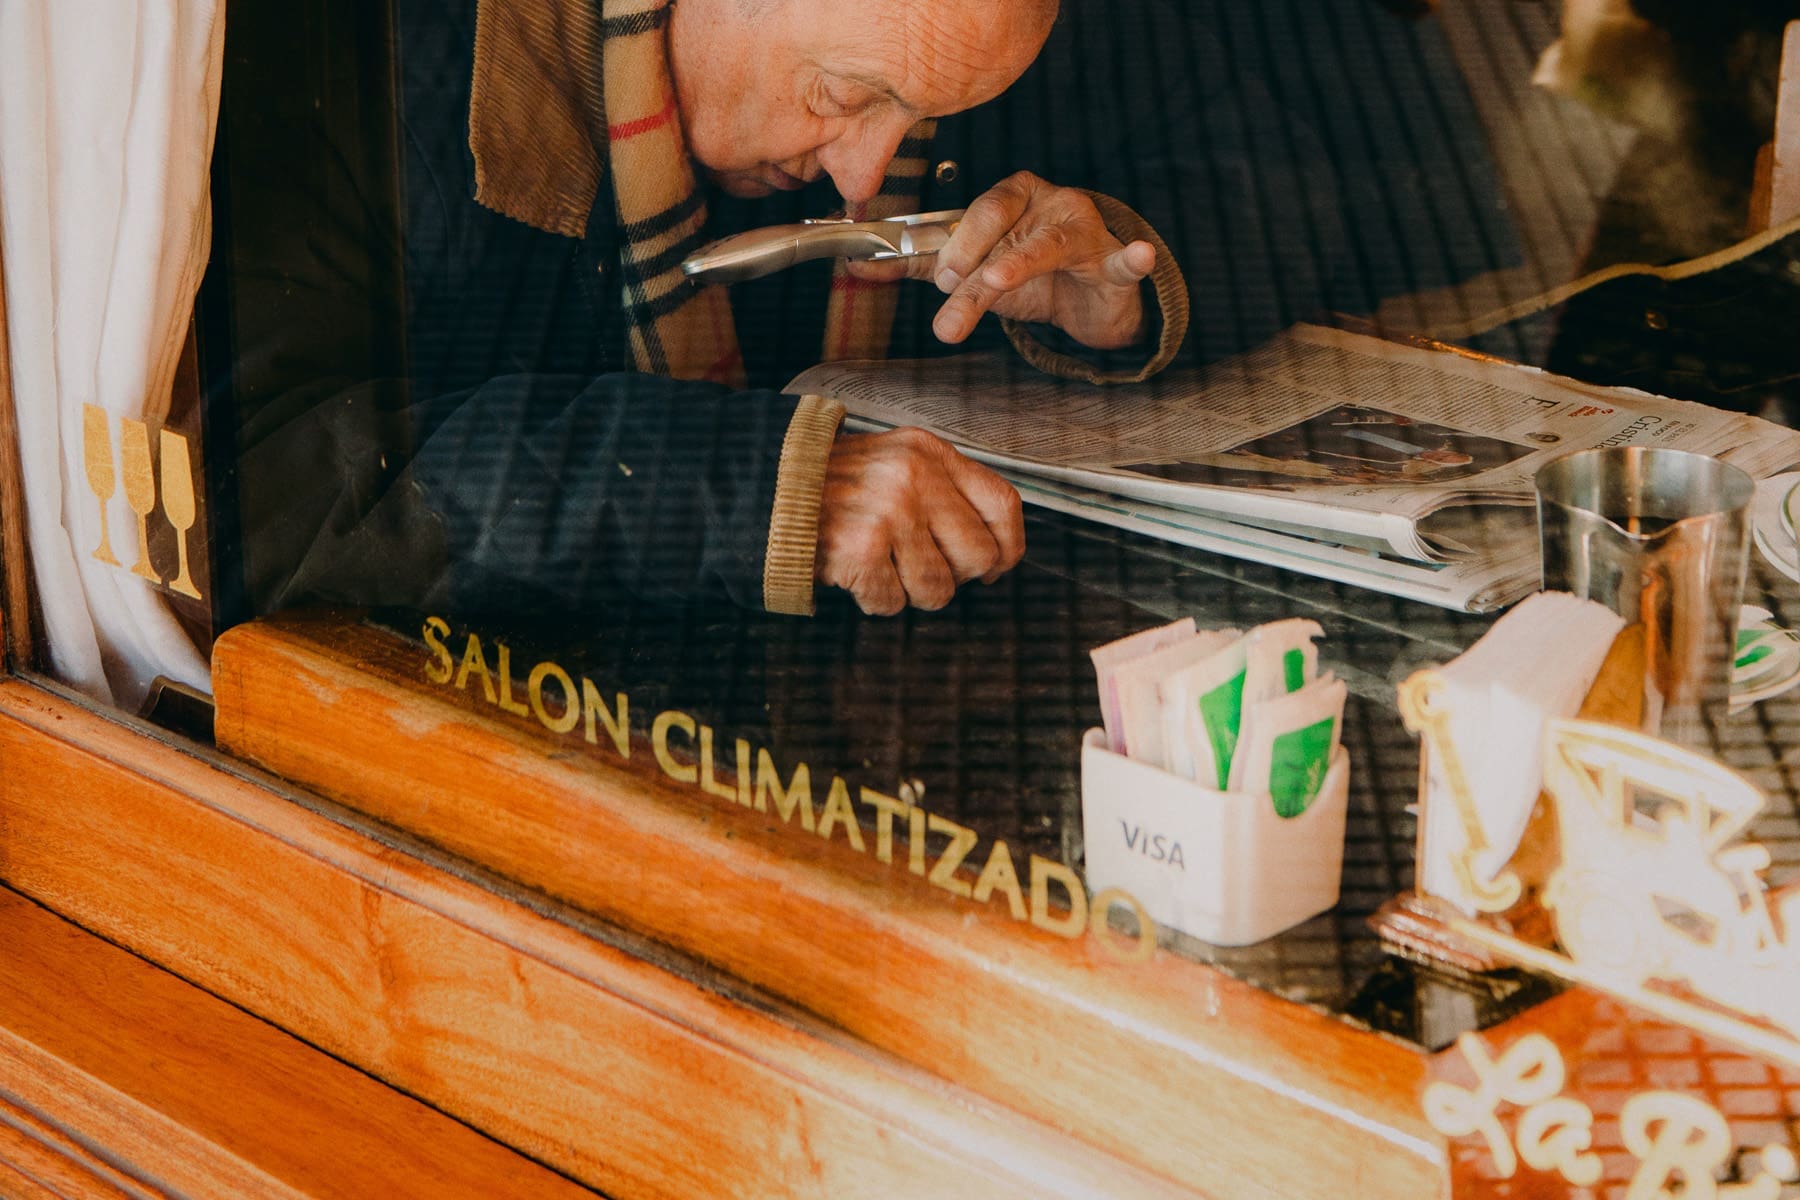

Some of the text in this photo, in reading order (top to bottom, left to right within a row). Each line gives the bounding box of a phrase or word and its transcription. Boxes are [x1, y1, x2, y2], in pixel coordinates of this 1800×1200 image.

[422, 616, 1156, 962] SALON CLIMATIZADO
[1119, 820, 1186, 871] VISA
